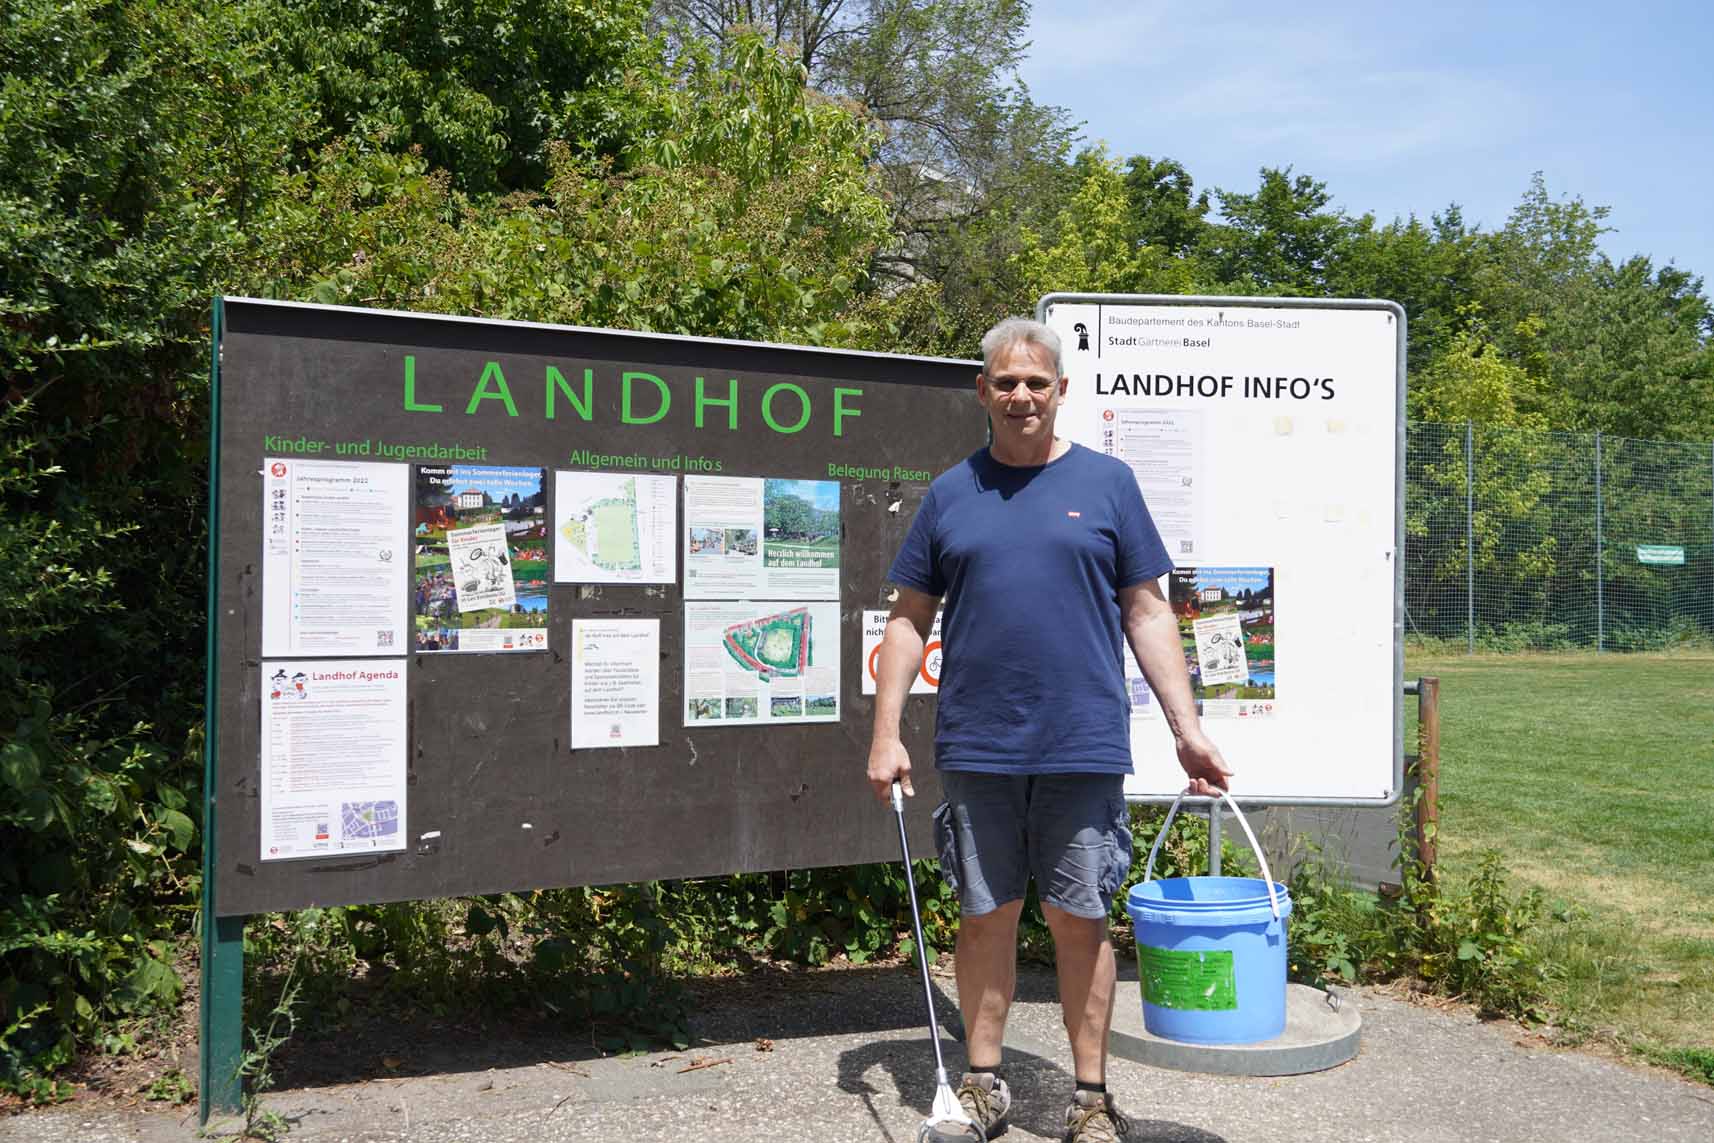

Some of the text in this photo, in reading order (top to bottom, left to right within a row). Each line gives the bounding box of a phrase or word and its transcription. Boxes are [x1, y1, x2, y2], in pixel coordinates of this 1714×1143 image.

[1108, 315, 1301, 330] Baudepartement des Kantons Basel-Stadt
[1095, 372, 1234, 398] LANDHOF
[404, 355, 863, 437] LANDHOF
[264, 435, 488, 461] Kinder- und Jugendarbeit
[570, 450, 648, 469] Allgemein
[651, 455, 680, 470] und
[827, 463, 931, 481] Belegung Rasen
[768, 549, 835, 559] Herzlich willkommen
[768, 559, 779, 567] auf
[866, 627, 884, 637] nich
[312, 670, 399, 682] Landhof Agenda
